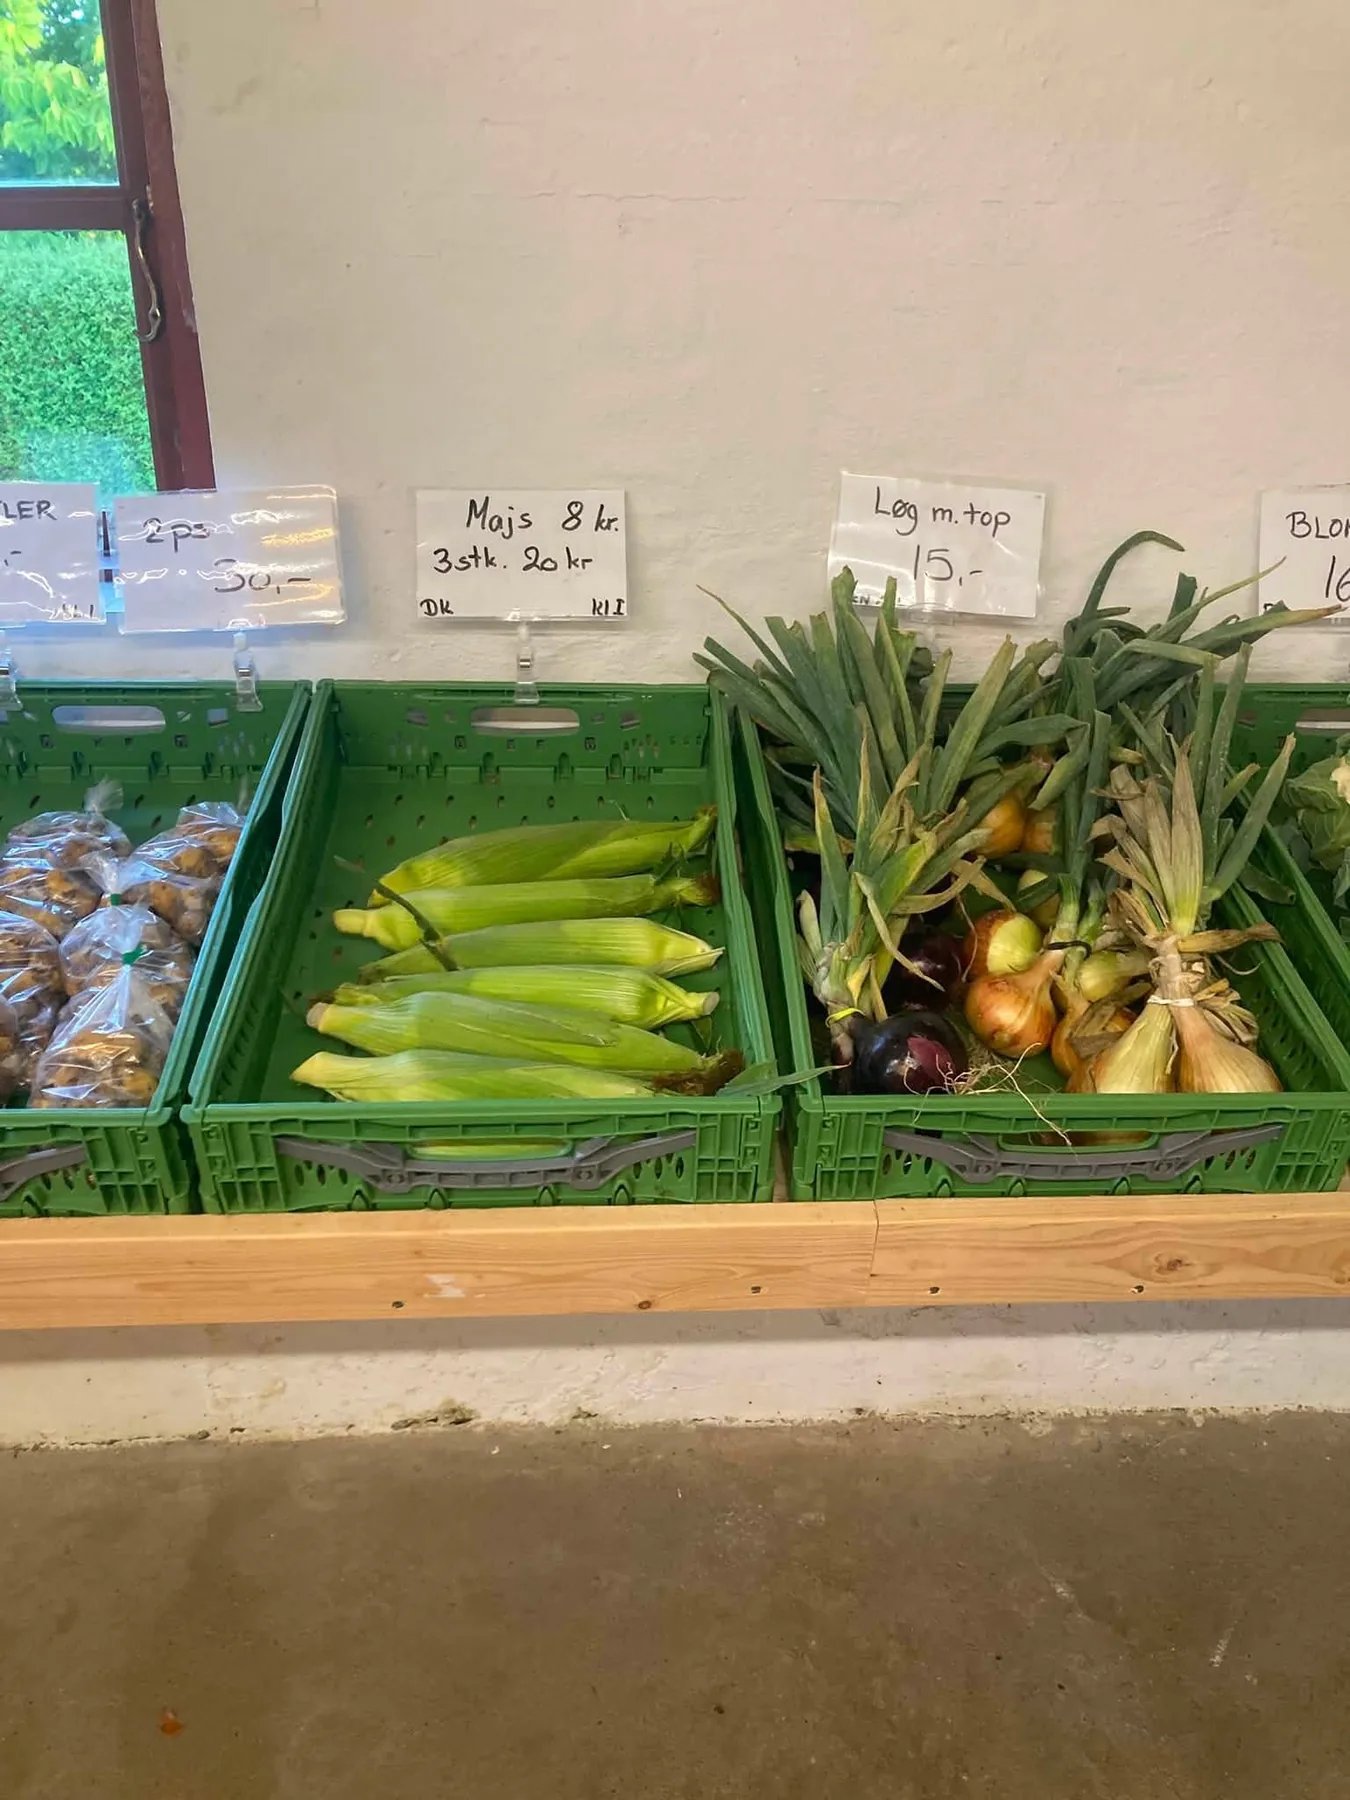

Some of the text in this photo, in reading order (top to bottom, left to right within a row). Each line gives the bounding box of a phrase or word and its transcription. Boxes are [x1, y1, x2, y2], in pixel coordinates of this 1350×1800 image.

[0, 500, 57, 520] LER
[466, 496, 533, 540] Majs
[561, 501, 584, 531] 8
[875, 486, 918, 536] Løg
[522, 546, 558, 572] 20
[565, 547, 593, 570] kr
